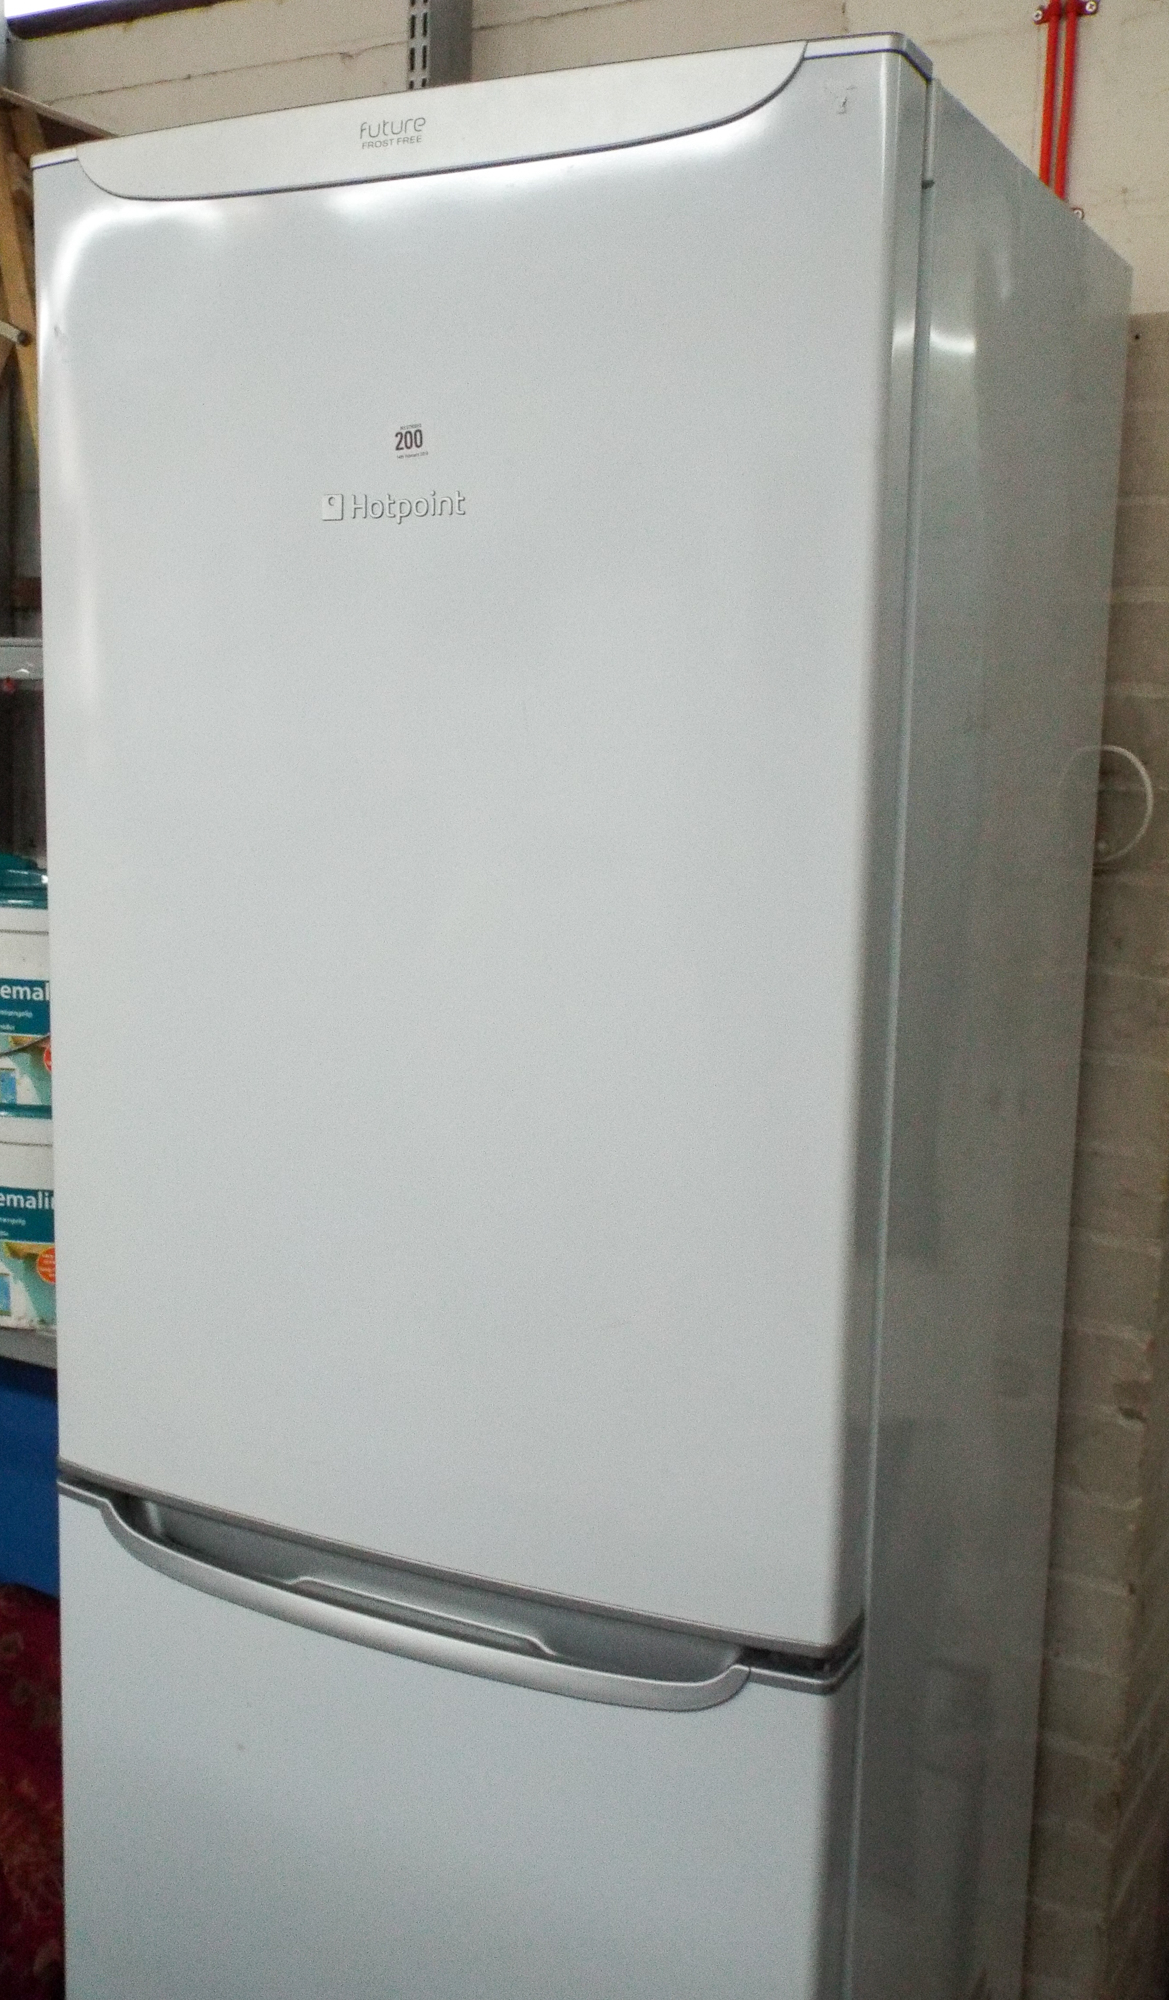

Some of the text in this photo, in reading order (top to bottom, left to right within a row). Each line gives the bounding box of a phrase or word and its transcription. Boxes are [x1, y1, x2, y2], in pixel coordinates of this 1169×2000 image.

[360, 117, 426, 139] future
[361, 135, 422, 149] FROST FREE
[395, 429, 423, 451] 200
[351, 490, 466, 525] Hotpoint
